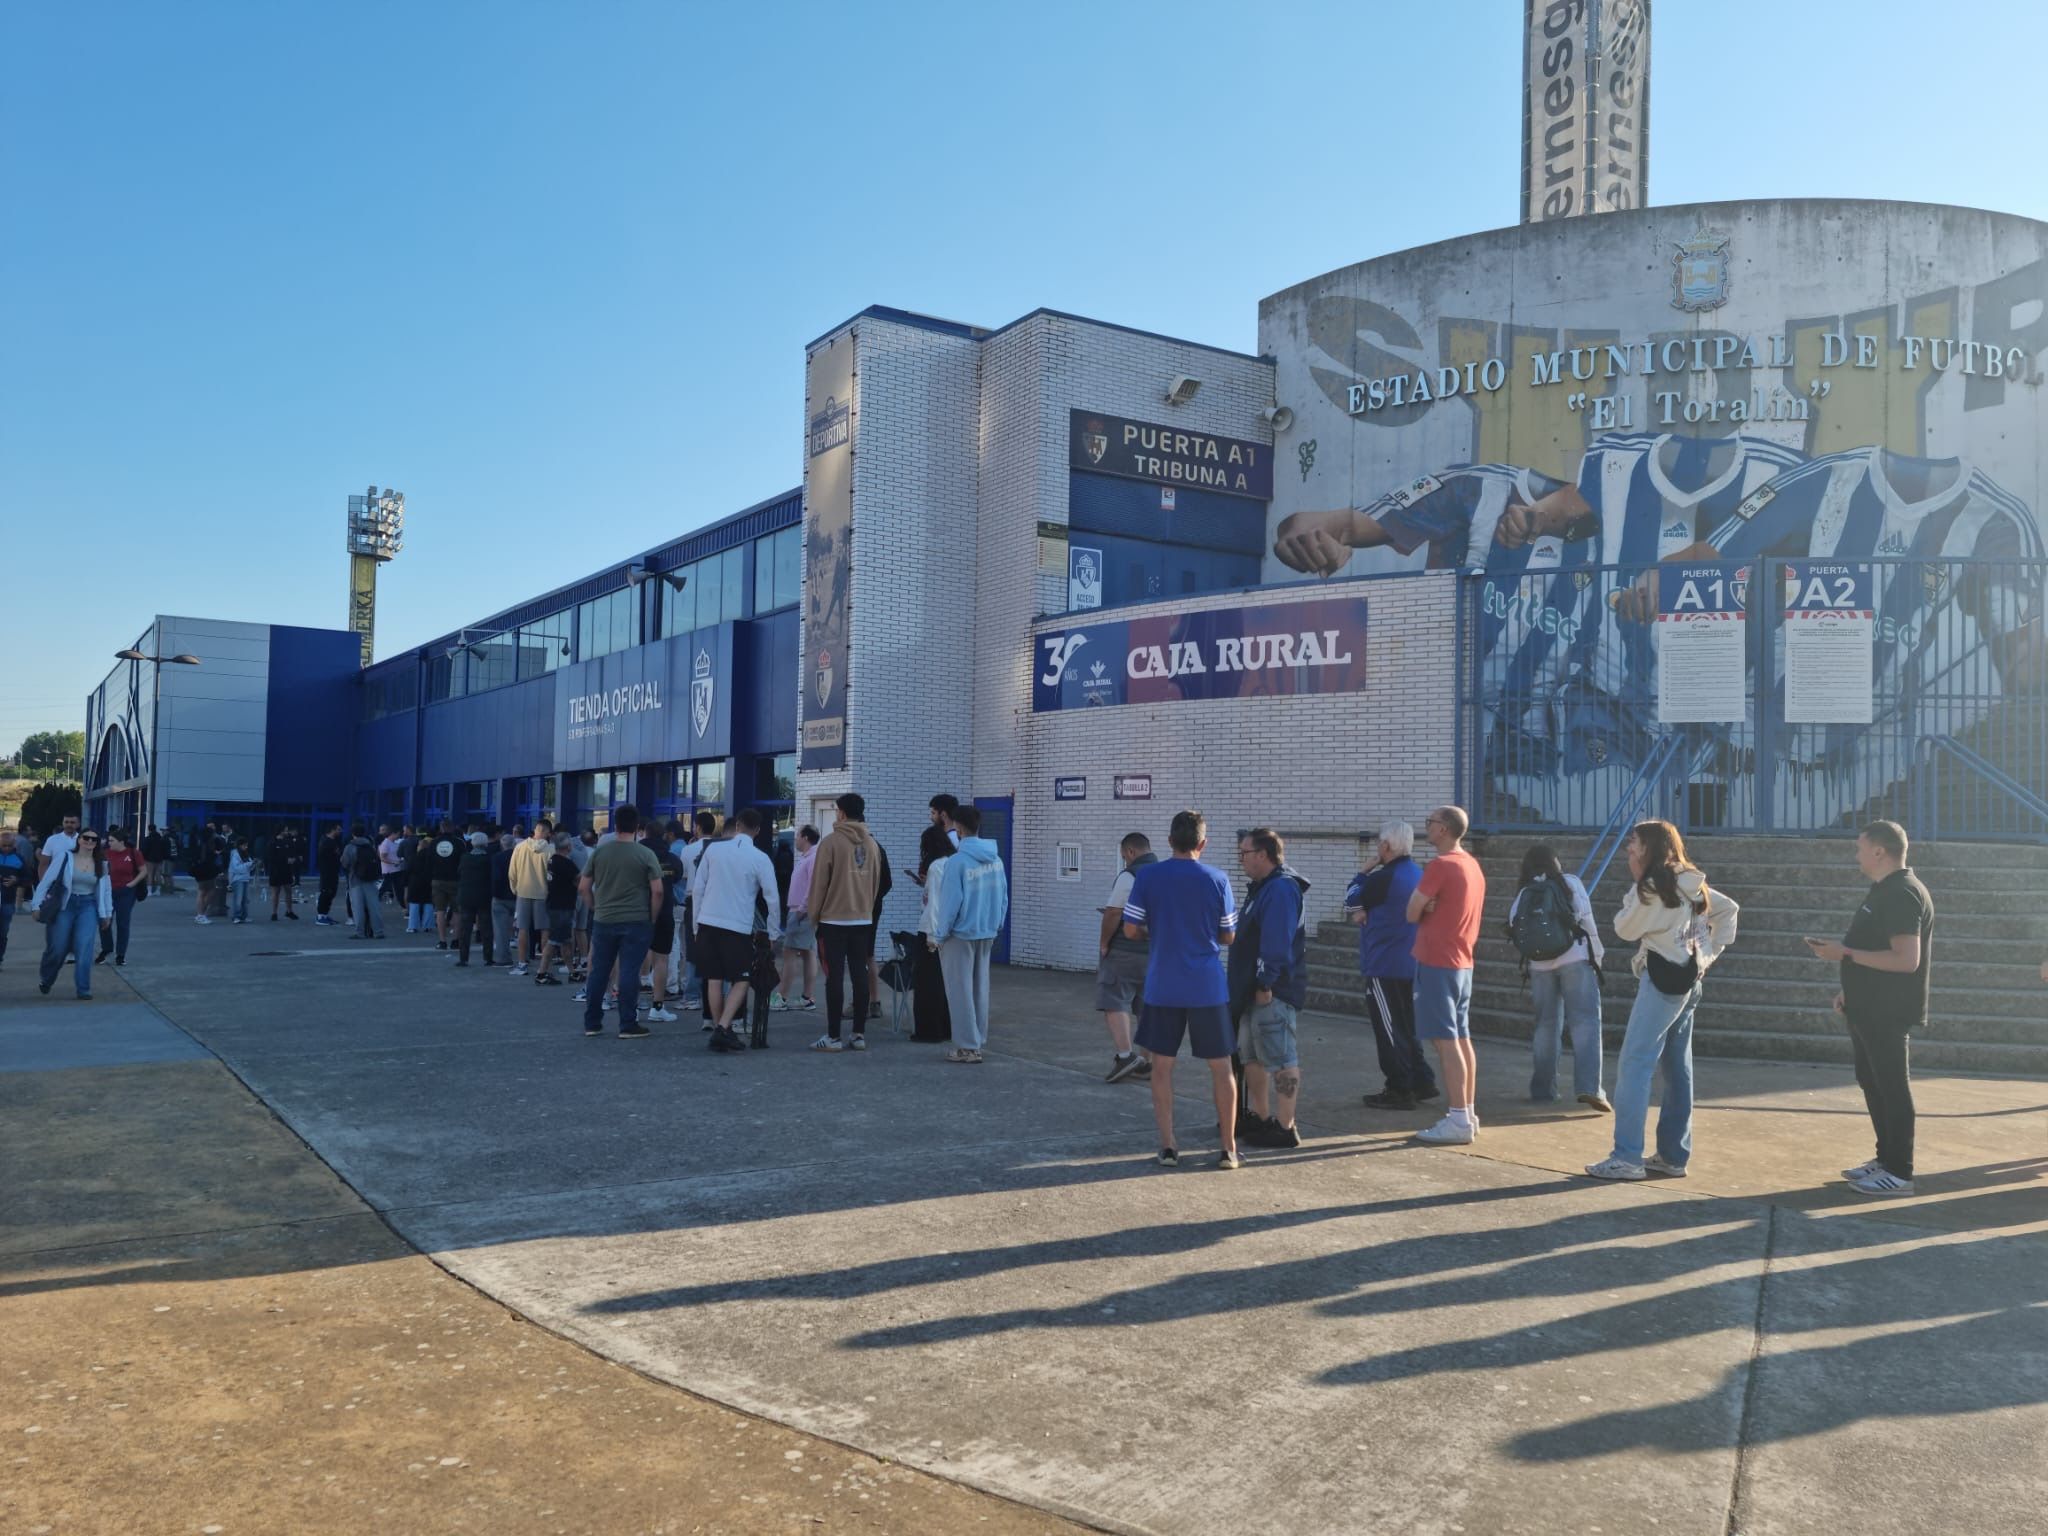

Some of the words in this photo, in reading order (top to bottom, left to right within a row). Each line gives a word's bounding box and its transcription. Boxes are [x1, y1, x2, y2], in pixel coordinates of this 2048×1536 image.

[1347, 358, 1505, 415] ESTADIO
[1531, 335, 1795, 387] MUNICIPAL
[1821, 333, 1878, 368] DE
[1123, 424, 1219, 461] PUERTA
[1227, 444, 1255, 467] A1
[1134, 454, 1227, 487] TRIBUNA
[1235, 472, 1248, 490] A
[1682, 569, 1722, 578] PUERTA
[1809, 566, 1849, 575] PUERTA
[1674, 579, 1723, 610] A1
[1801, 577, 1856, 607] A2
[356, 590, 372, 668] LIMERKA
[1127, 641, 1206, 680] CAJA
[1215, 630, 1352, 672] RURAL
[569, 691, 610, 724] TIENDA
[612, 680, 662, 716] OFICIAL
